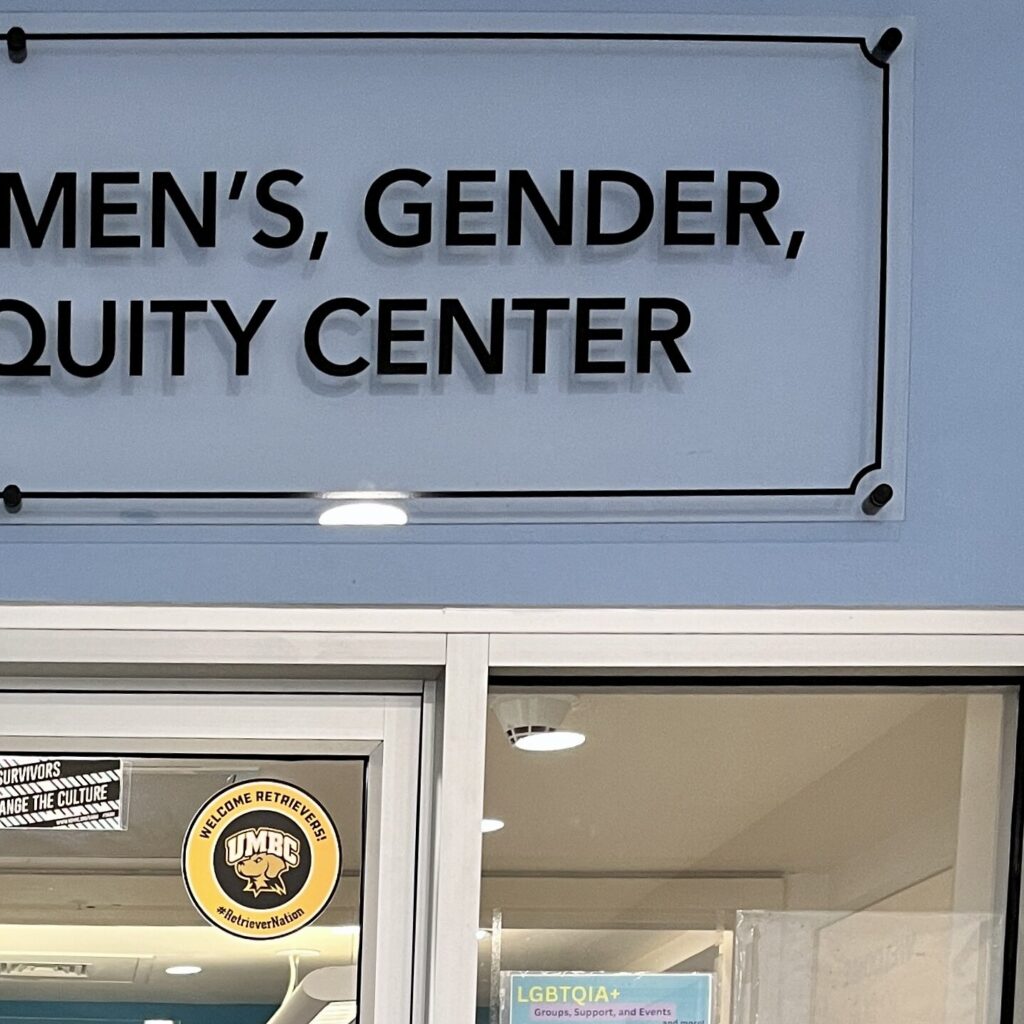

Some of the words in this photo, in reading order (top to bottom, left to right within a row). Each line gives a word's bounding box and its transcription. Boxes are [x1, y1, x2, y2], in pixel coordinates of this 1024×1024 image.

[364, 168, 805, 259] GENDER,
[304, 297, 692, 377] CENTER
[32, 794, 55, 811] THE
[57, 784, 108, 808] CULTURE
[199, 792, 252, 839] WELCOME
[256, 790, 327, 842] RETRIEVERS!
[226, 829, 299, 866] UMBC
[216, 906, 305, 930] #RetrieverNation
[517, 985, 621, 1006] LGBTQIA+
[534, 1008, 572, 1018] Groups,
[574, 1008, 616, 1018] Support,
[618, 1007, 636, 1017] and
[639, 1008, 671, 1017] Events
